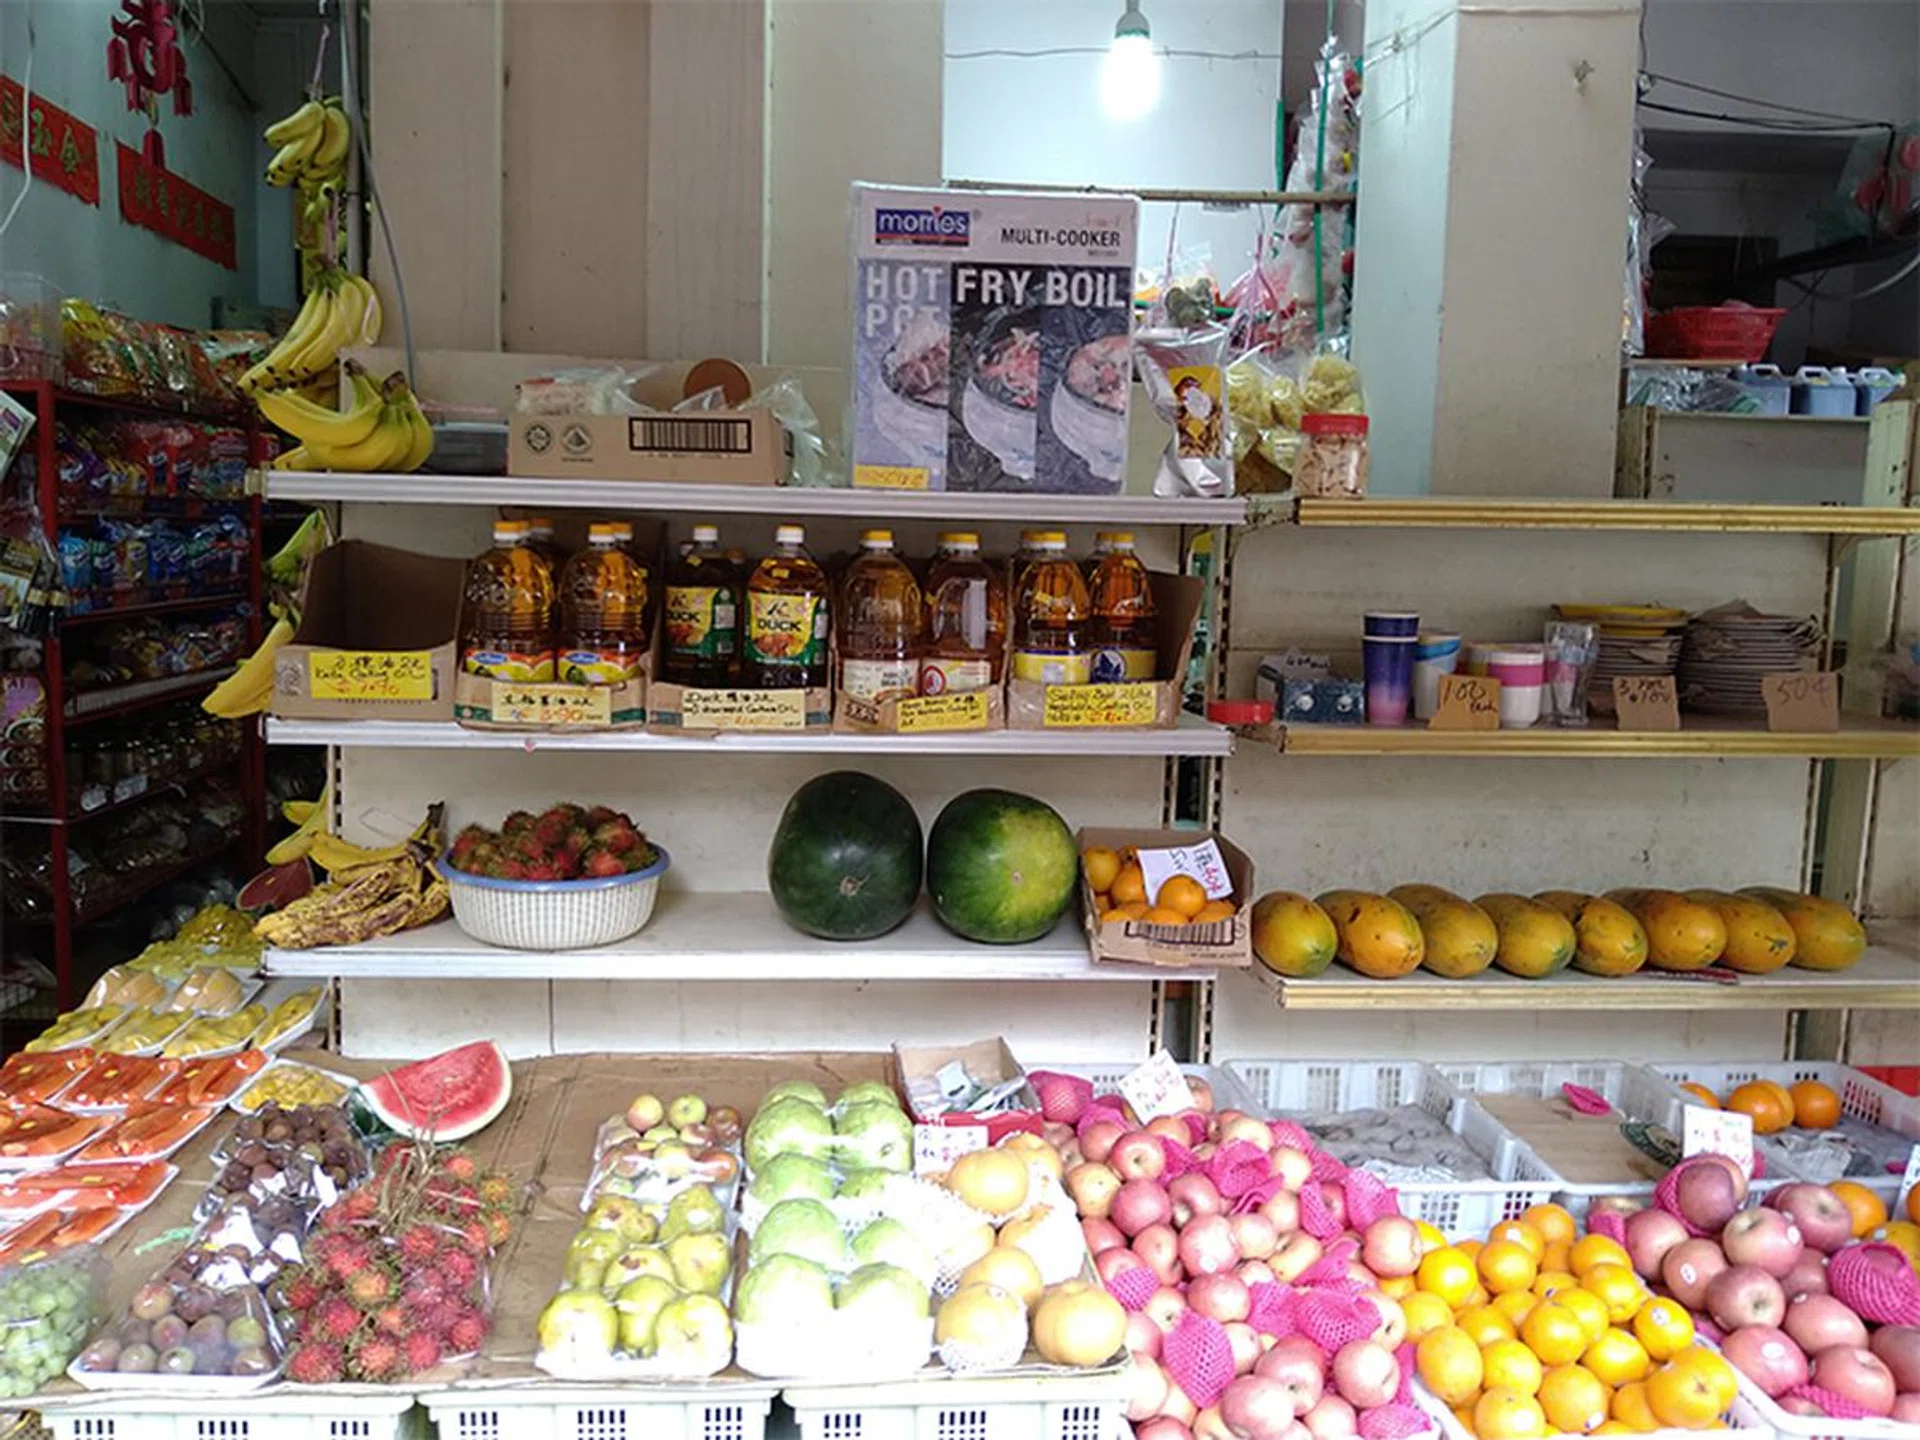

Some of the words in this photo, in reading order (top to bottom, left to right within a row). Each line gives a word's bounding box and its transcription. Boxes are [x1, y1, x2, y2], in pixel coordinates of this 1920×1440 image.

[1000, 228, 1121, 247] MULTI-COOKER
[866, 266, 943, 302] HOT
[956, 268, 1031, 305] FRY
[1045, 271, 1126, 308] BOIL
[667, 611, 701, 624] UCK
[758, 618, 803, 632] DUCK
